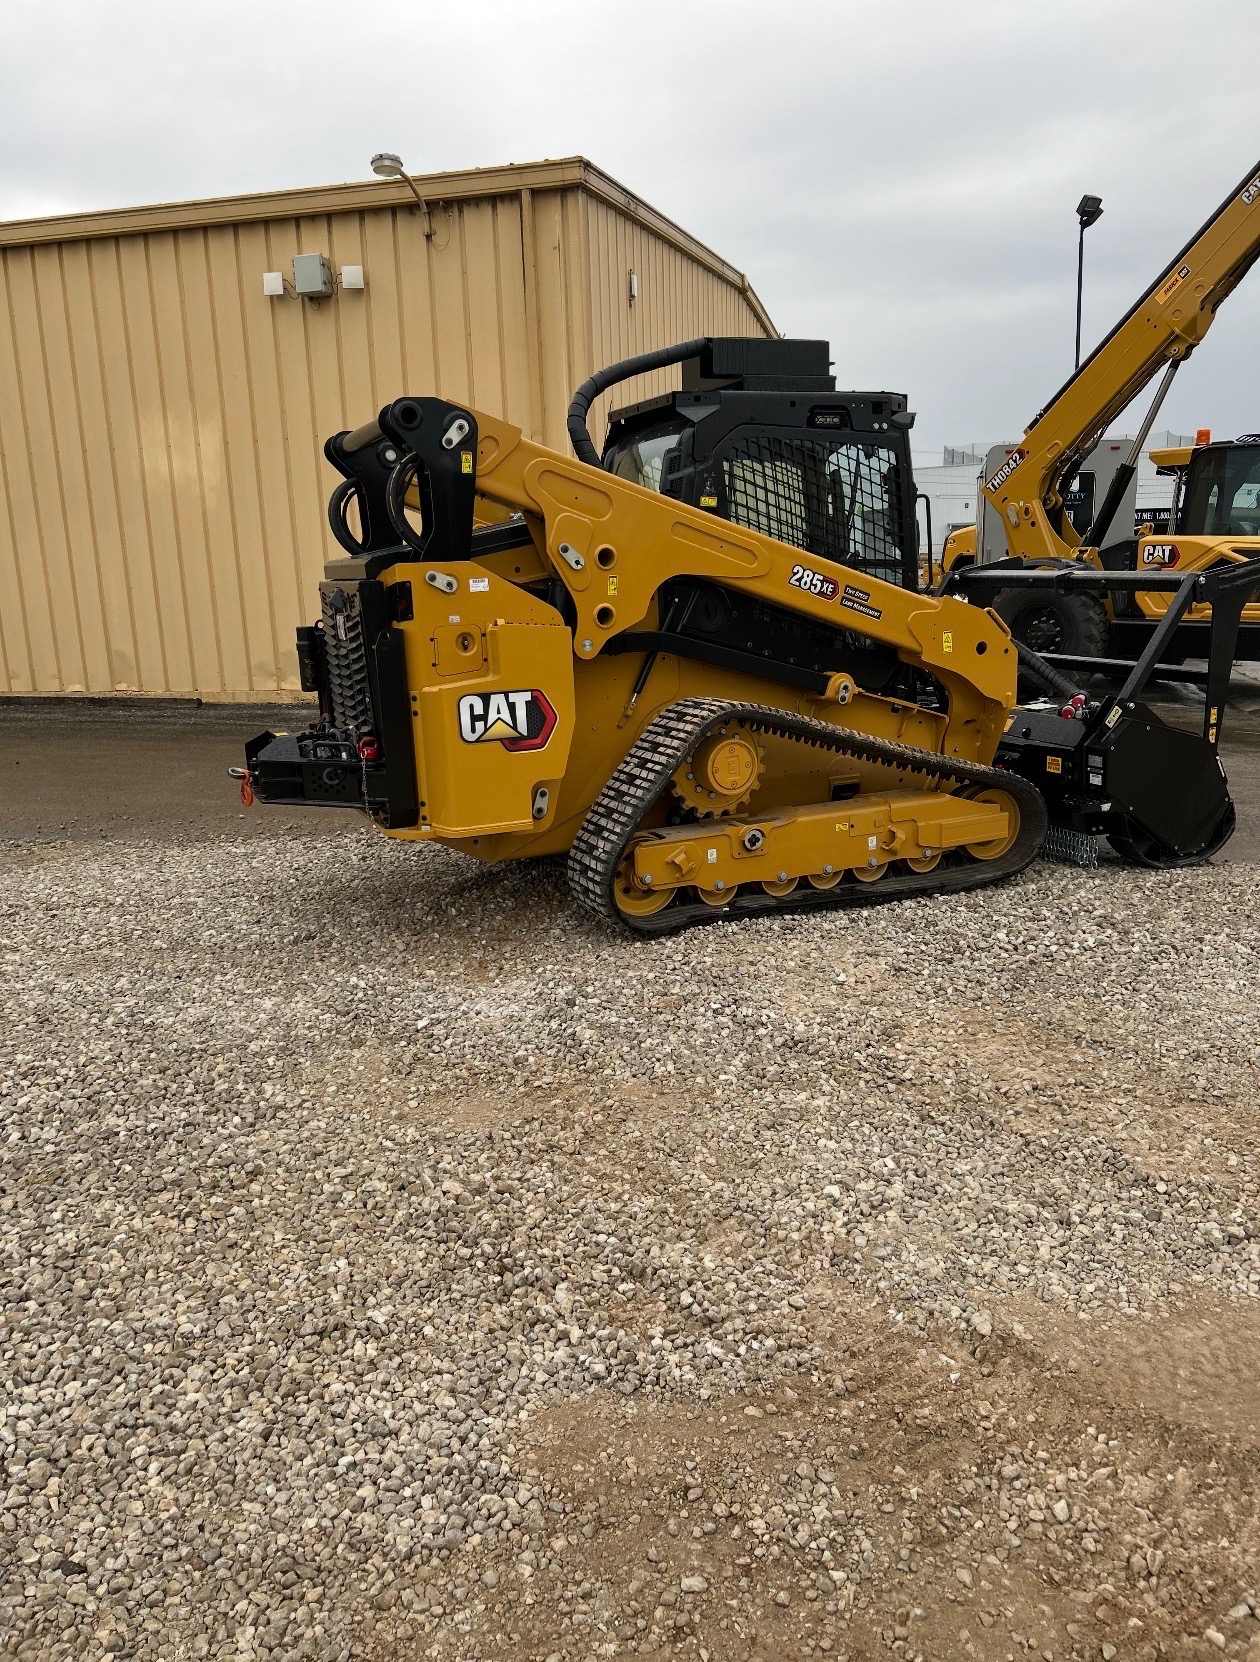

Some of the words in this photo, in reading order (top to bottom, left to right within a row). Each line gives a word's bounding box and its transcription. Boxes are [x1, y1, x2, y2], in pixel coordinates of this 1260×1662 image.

[1241, 178, 1260, 205] CAT
[1143, 545, 1172, 564] CAT
[459, 691, 532, 742] CAT
